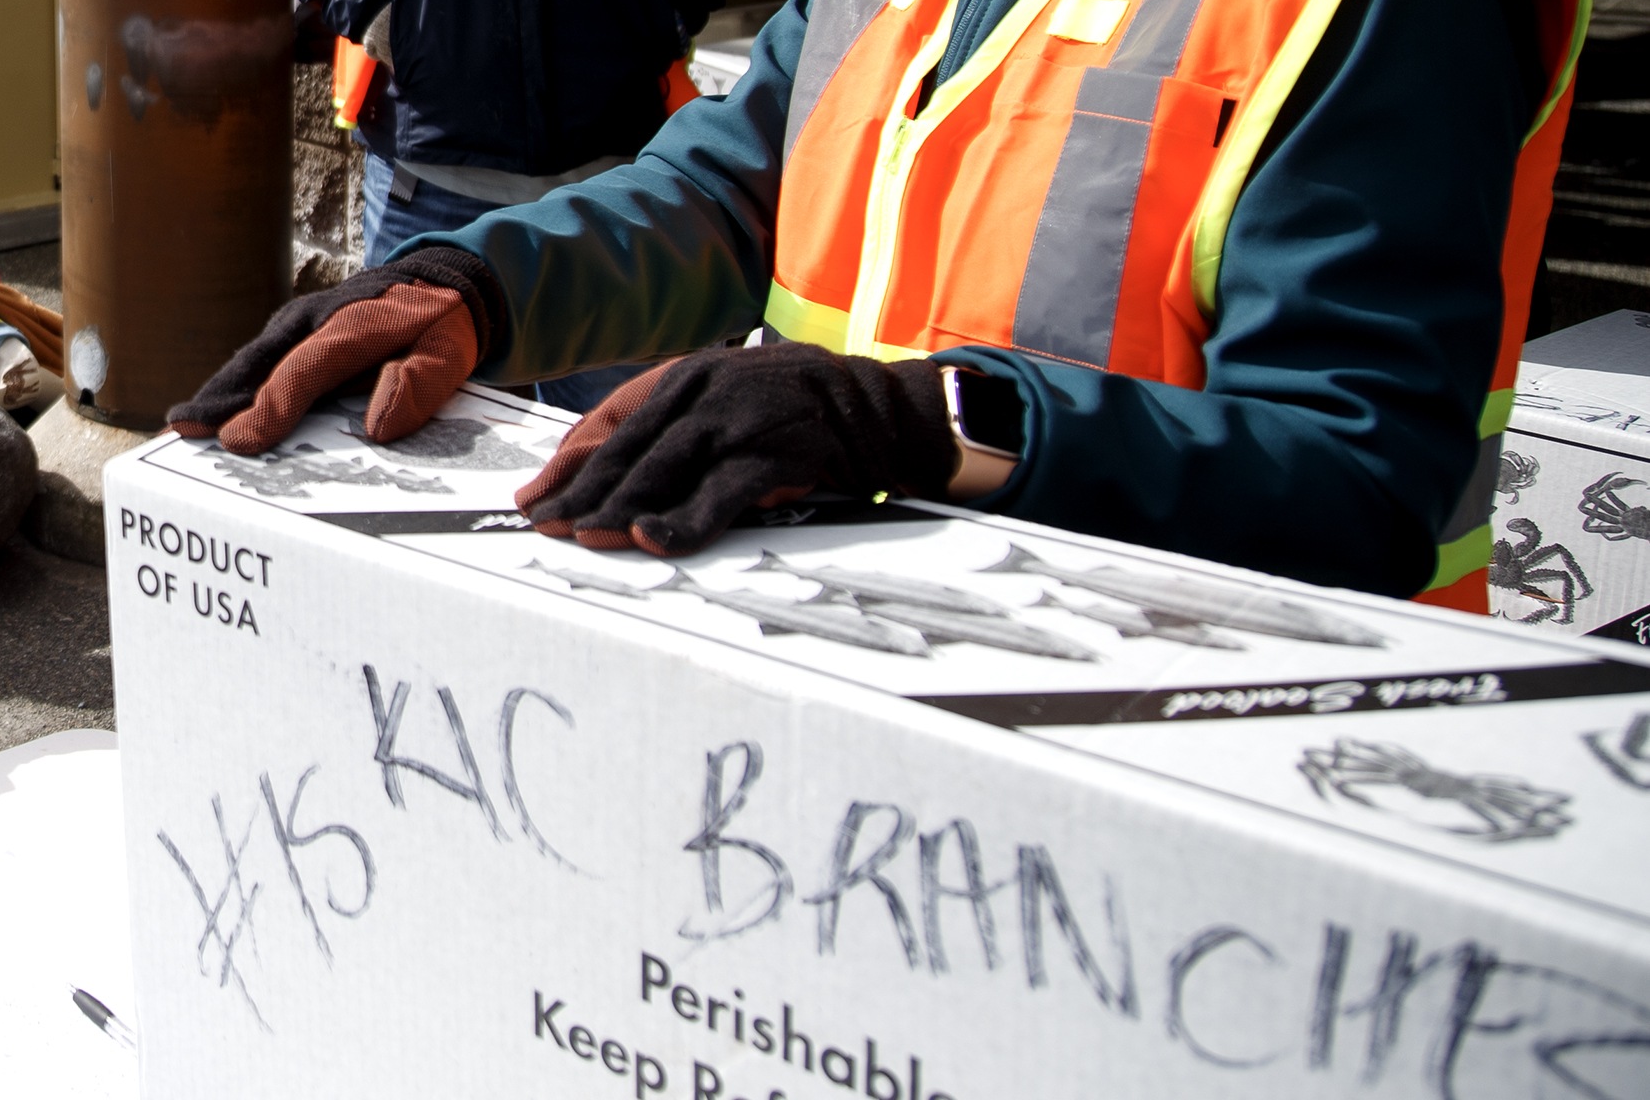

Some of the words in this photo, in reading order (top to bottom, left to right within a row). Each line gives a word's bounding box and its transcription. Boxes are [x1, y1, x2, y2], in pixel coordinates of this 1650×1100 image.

[121, 507, 274, 589] PRODUCT
[137, 564, 178, 604] OF
[192, 581, 261, 638] USA
[534, 990, 668, 1100] Keep
[641, 951, 958, 1100] Perishabl
